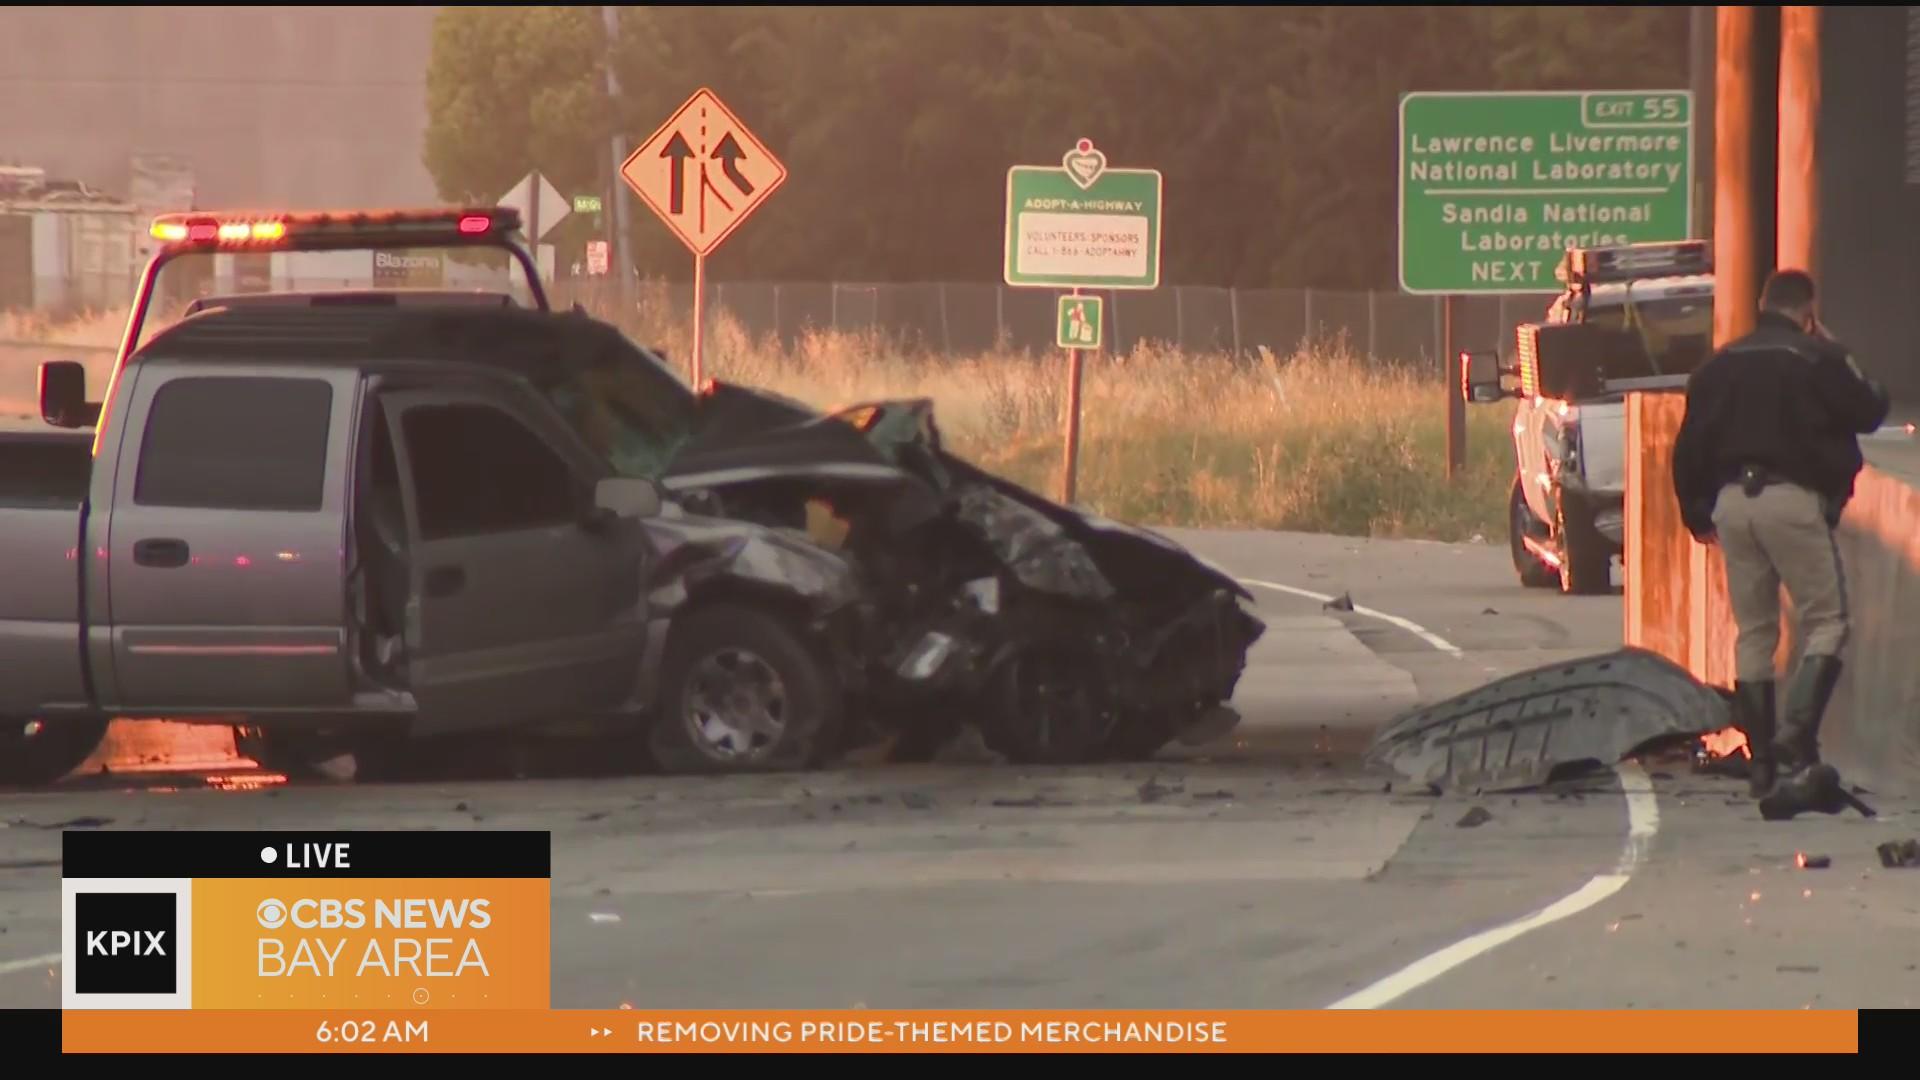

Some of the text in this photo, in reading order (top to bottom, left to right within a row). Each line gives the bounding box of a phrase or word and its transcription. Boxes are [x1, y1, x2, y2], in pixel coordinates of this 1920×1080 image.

[1595, 98, 1680, 119] EXIT 55
[1411, 133, 1681, 153] Lawrence Livermore
[1410, 161, 1682, 183] National Laboratory
[1442, 203, 1651, 223] Sandia National
[1461, 231, 1628, 251] Laboratories
[1472, 261, 1543, 281] NEXT
